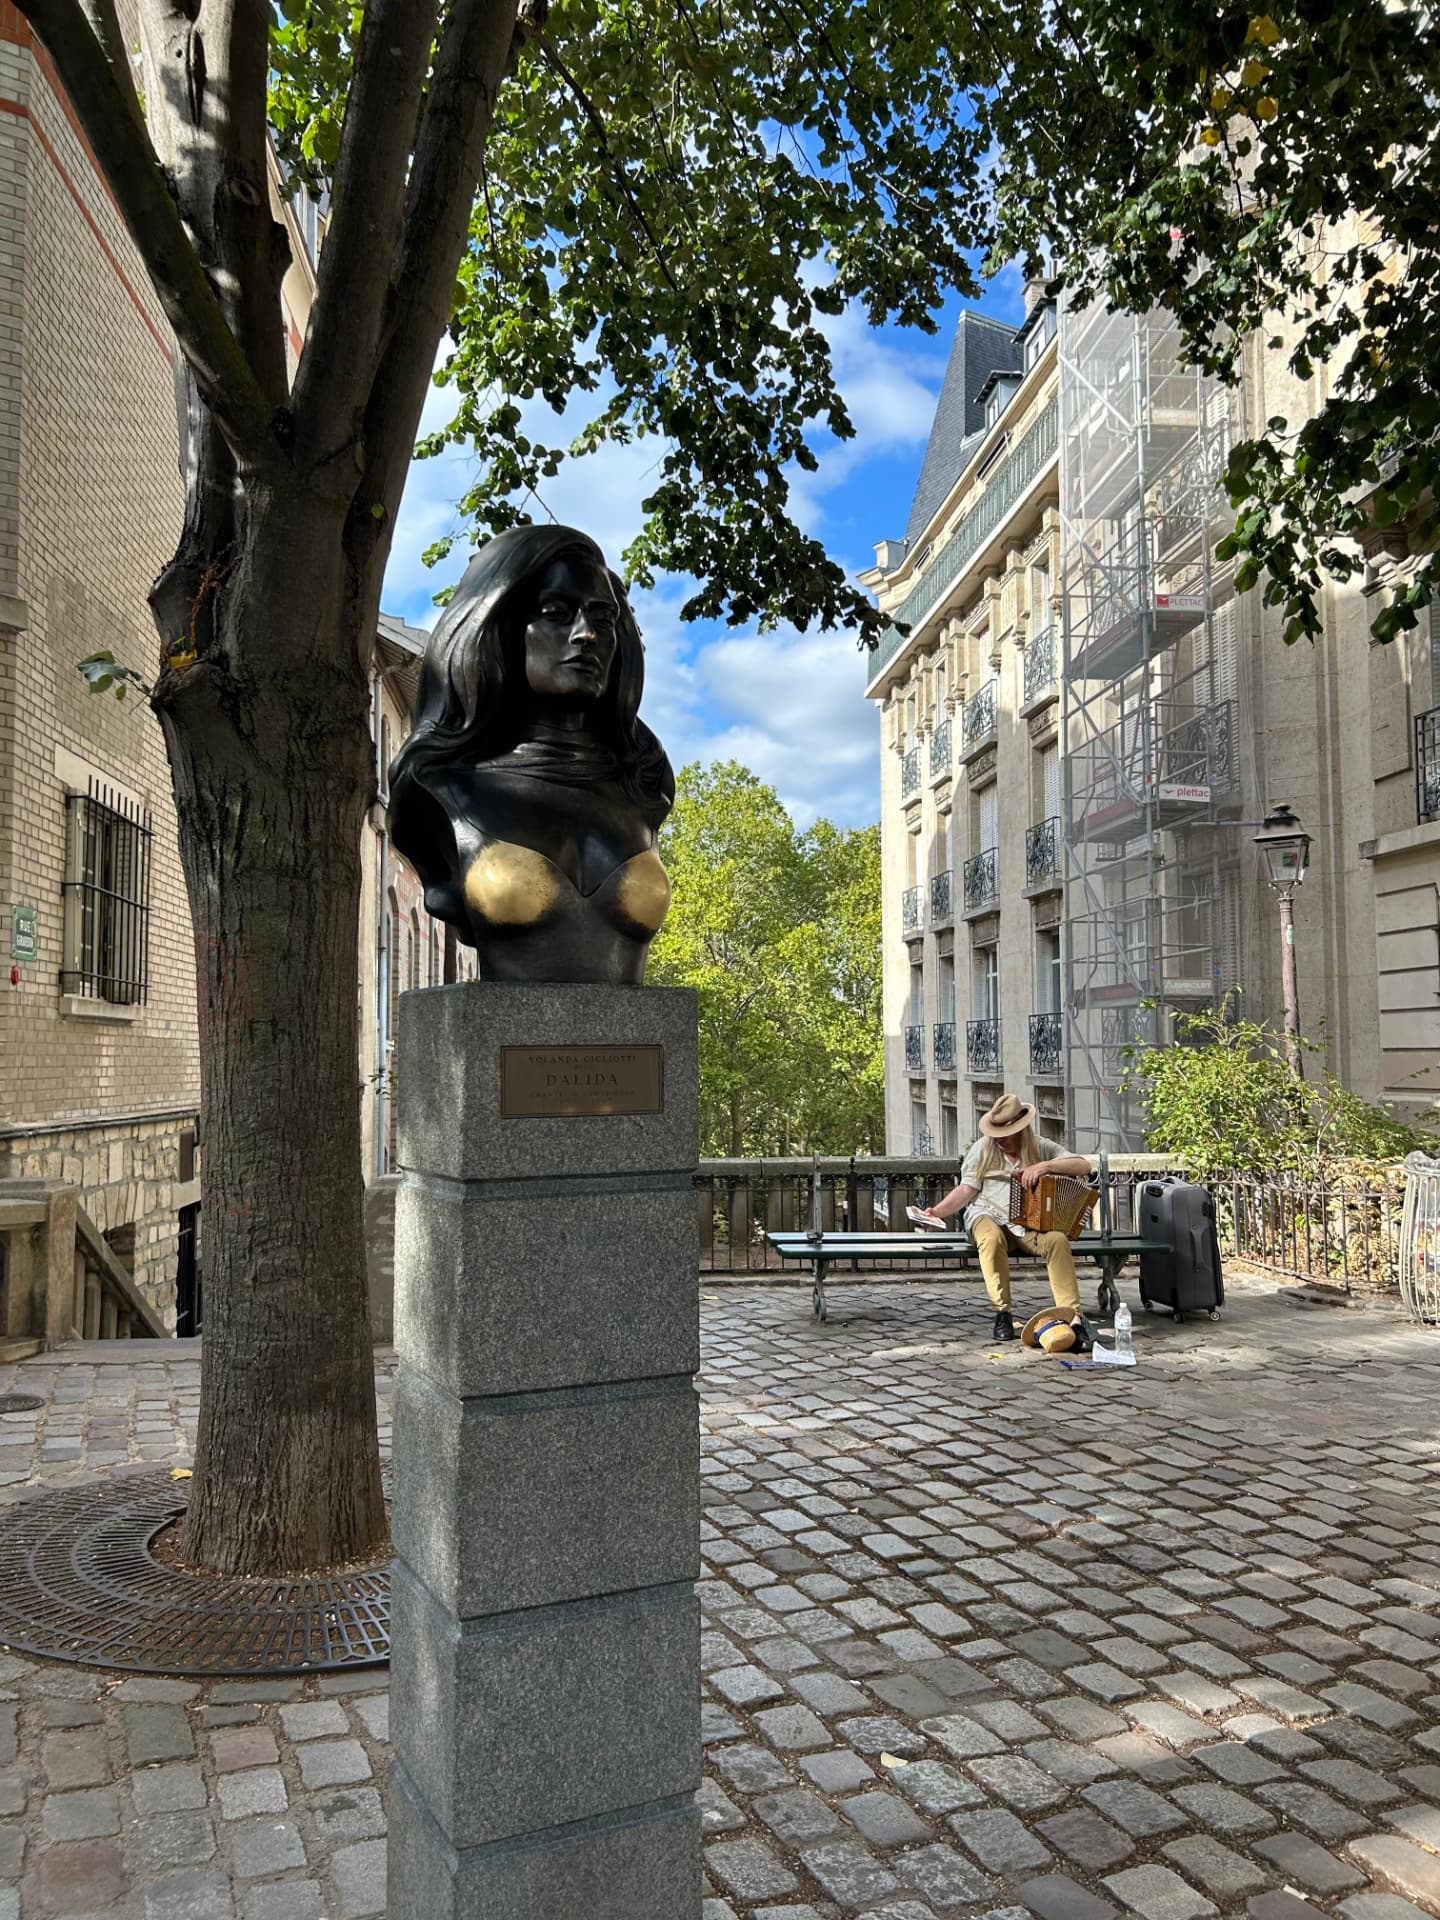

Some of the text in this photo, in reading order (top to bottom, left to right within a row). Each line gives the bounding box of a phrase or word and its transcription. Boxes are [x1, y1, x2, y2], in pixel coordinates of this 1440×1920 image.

[1176, 787, 1209, 798] plettac
[528, 1055, 579, 1064] YOLANDA
[546, 1073, 618, 1086] DALIDA
